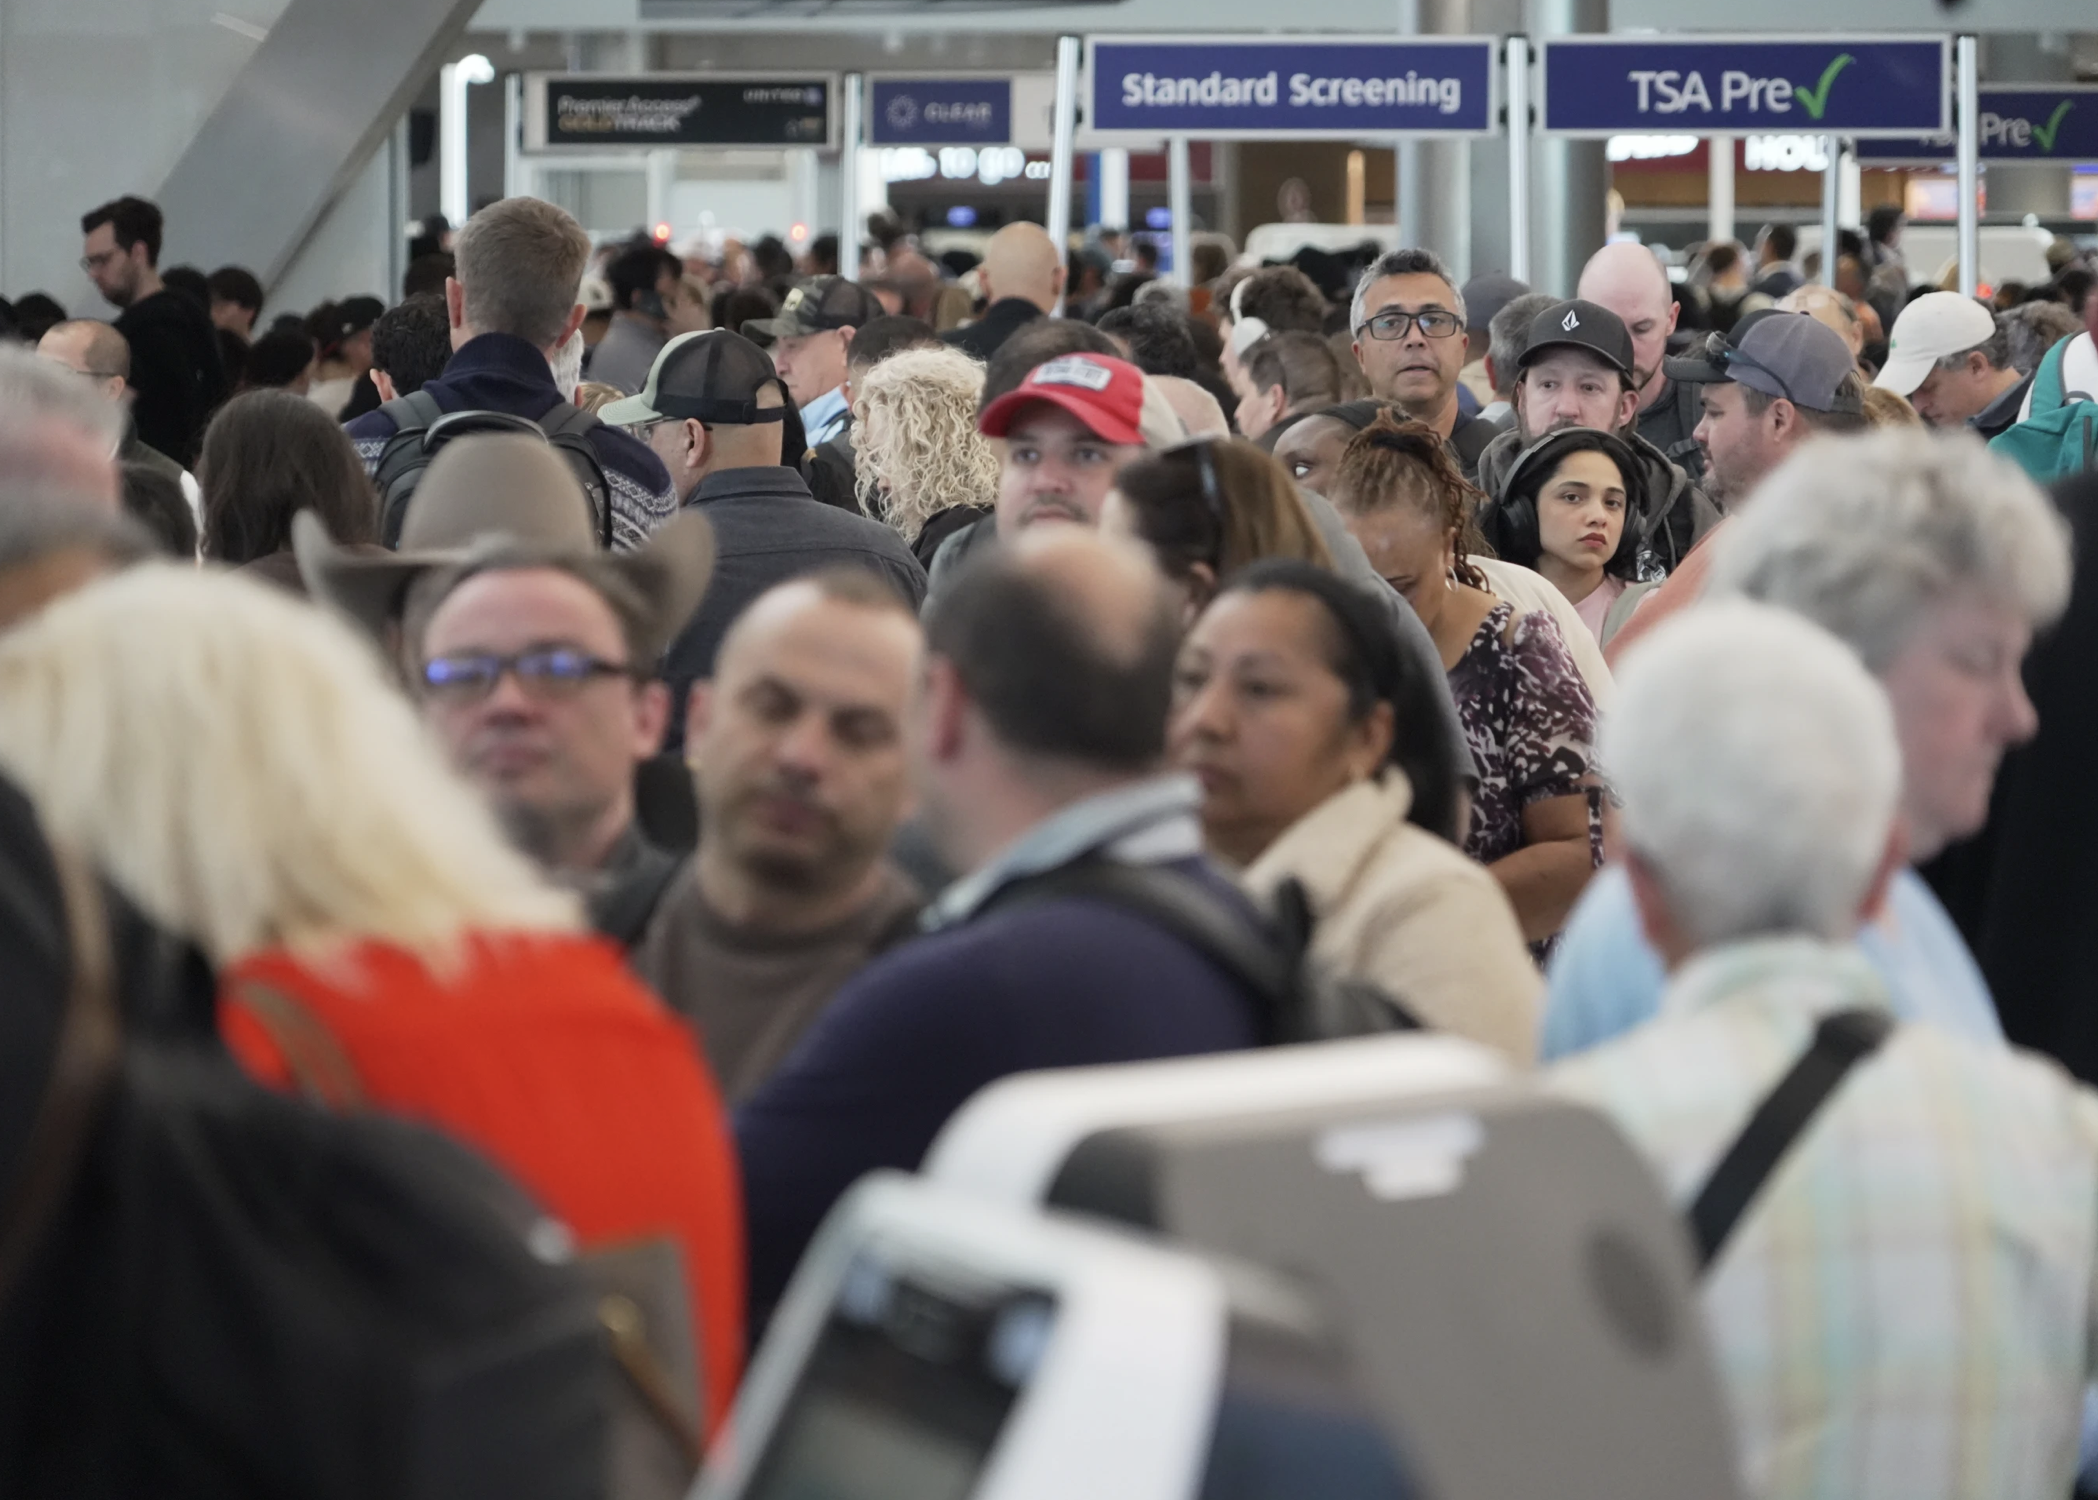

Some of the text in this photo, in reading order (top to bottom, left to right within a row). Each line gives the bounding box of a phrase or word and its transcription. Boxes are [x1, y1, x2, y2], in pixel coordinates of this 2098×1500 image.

[1122, 70, 1461, 115] Standard Screening
[1627, 70, 1793, 114] TSA Pre
[924, 102, 993, 124] CLEAR
[1980, 112, 2032, 147] Pre
